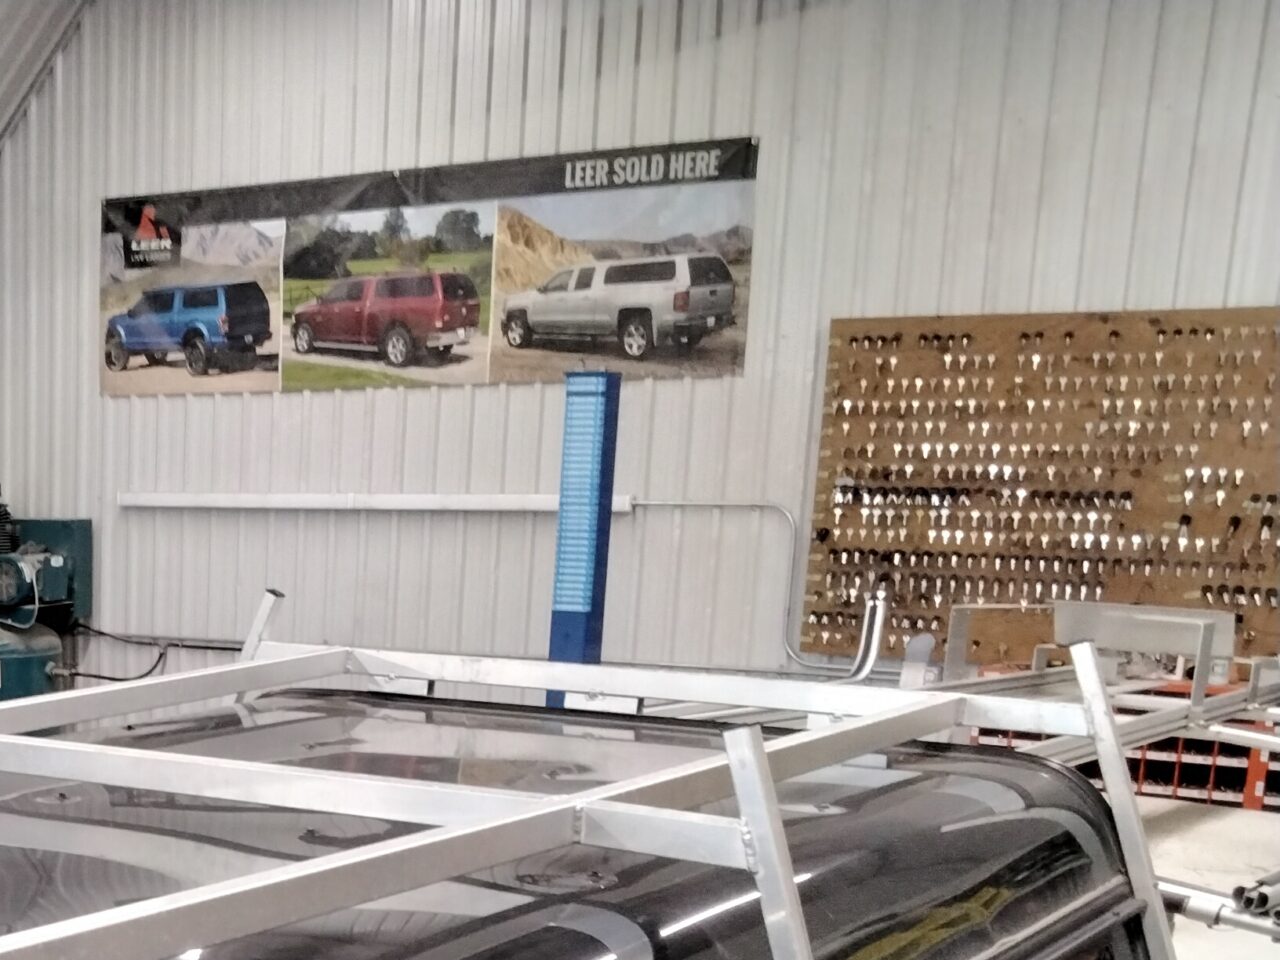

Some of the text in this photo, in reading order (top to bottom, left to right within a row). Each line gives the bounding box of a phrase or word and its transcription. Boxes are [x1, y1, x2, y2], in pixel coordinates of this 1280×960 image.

[565, 148, 722, 189] LEER SOLD HERE
[131, 238, 173, 252] LEER
